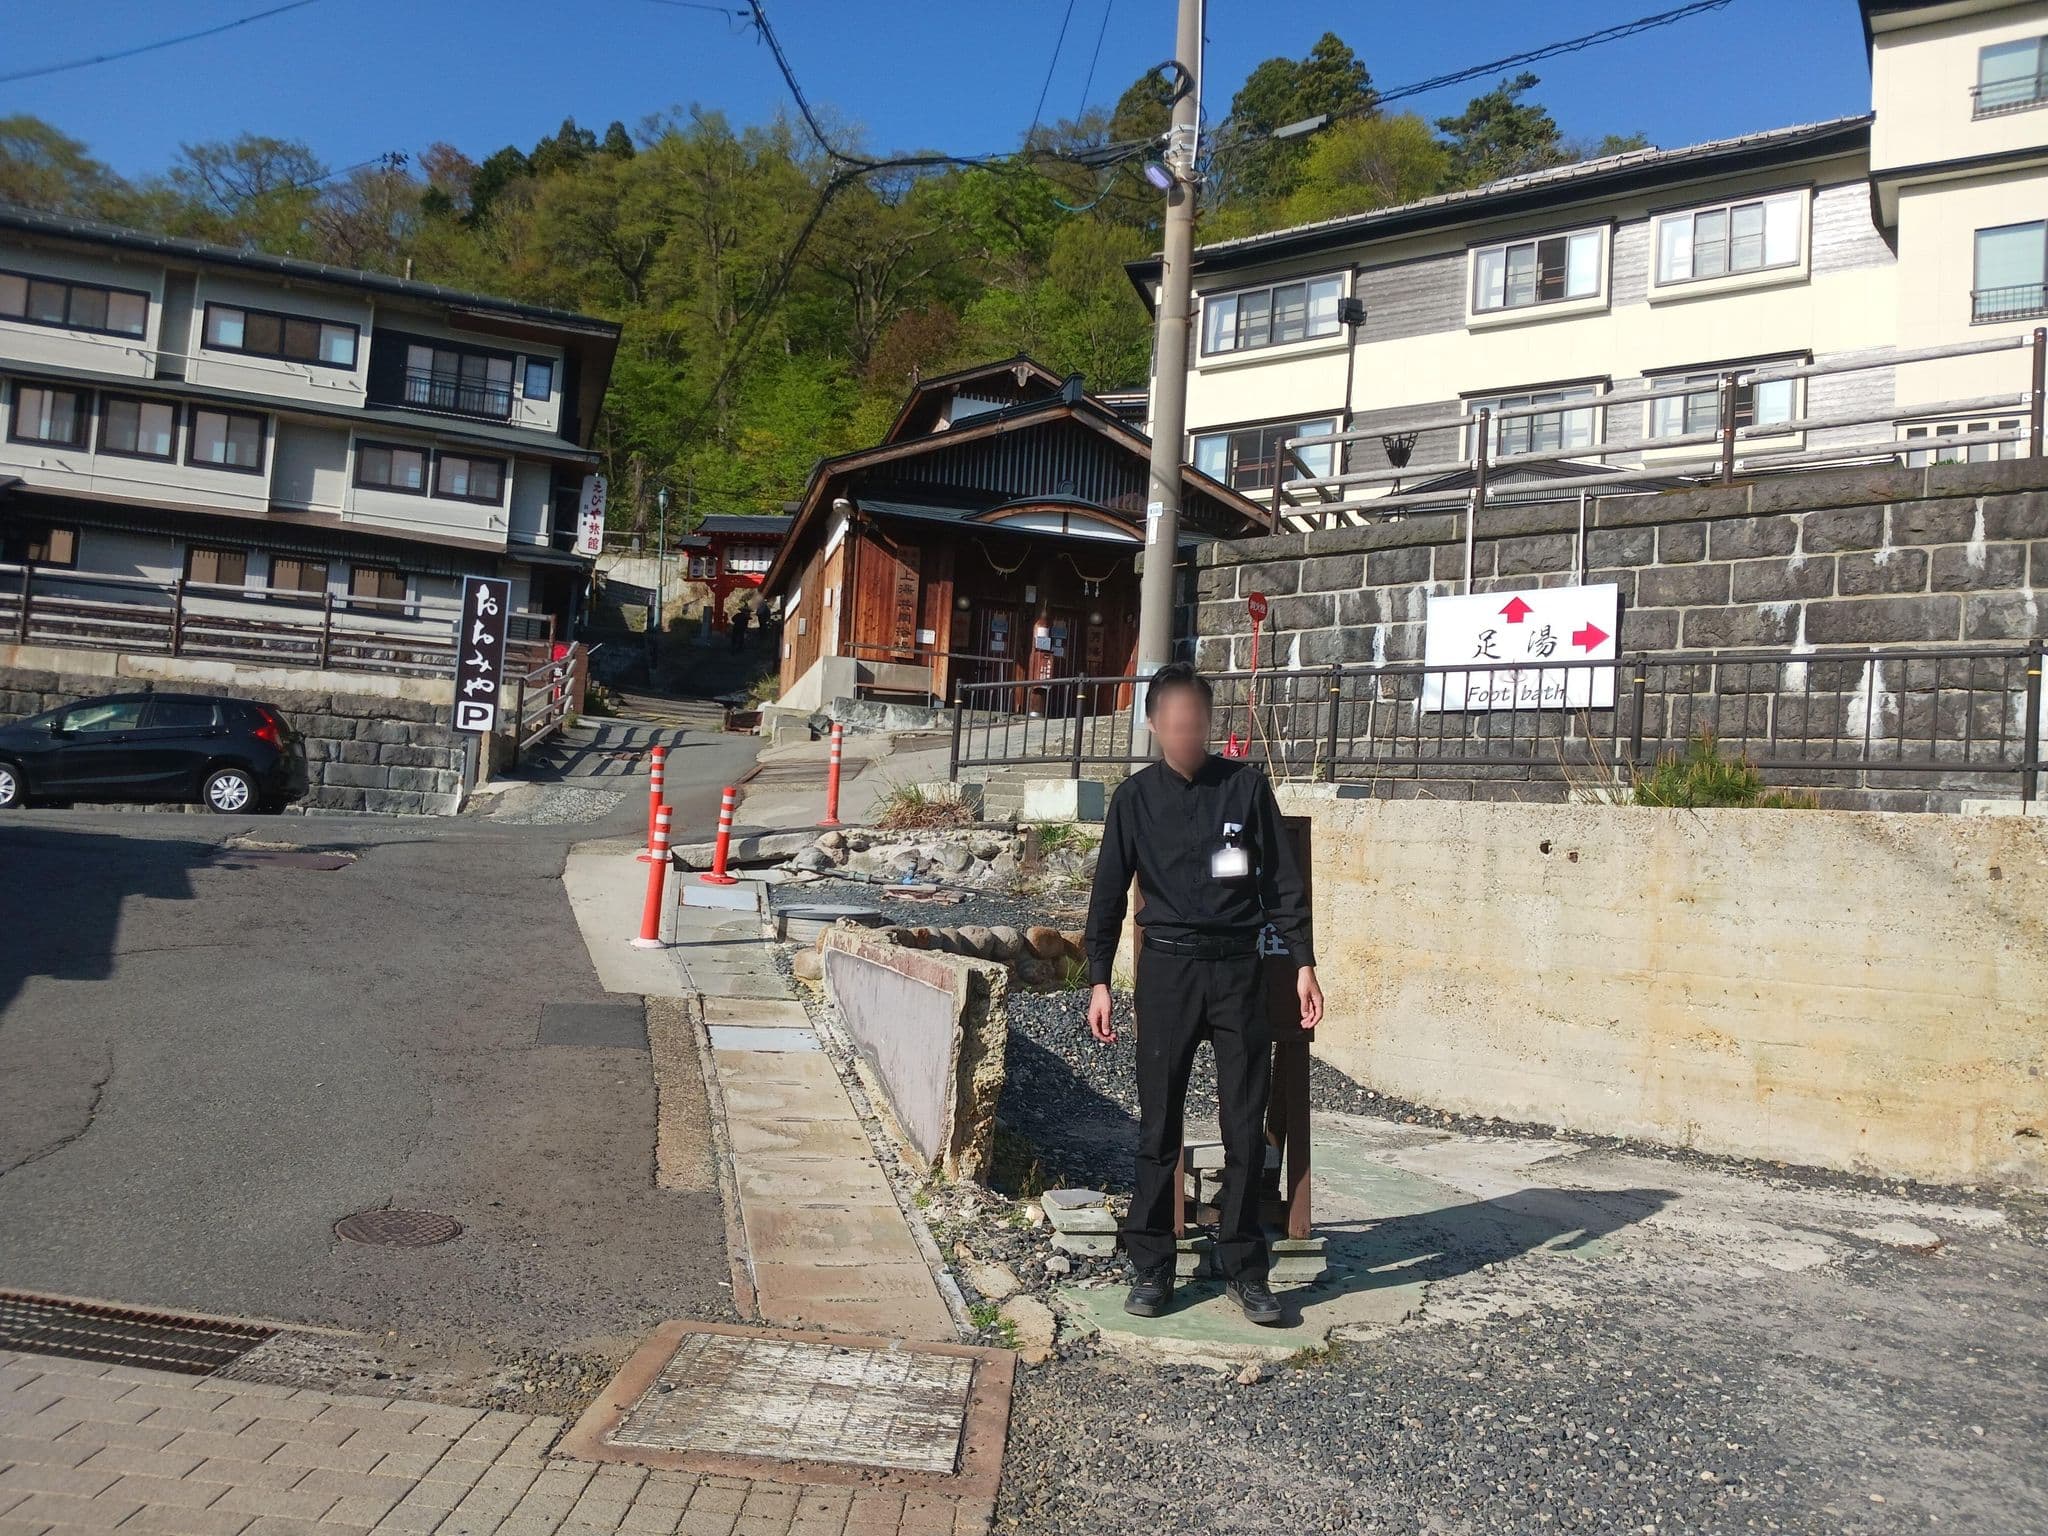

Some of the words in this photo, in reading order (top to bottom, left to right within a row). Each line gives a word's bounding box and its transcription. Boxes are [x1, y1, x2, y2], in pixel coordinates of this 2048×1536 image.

[587, 480, 603, 551] えびや旅館
[1472, 624, 1557, 659] 足湯
[1467, 686, 1511, 702] Foot
[1520, 684, 1566, 701] bath
[462, 705, 489, 726] P
